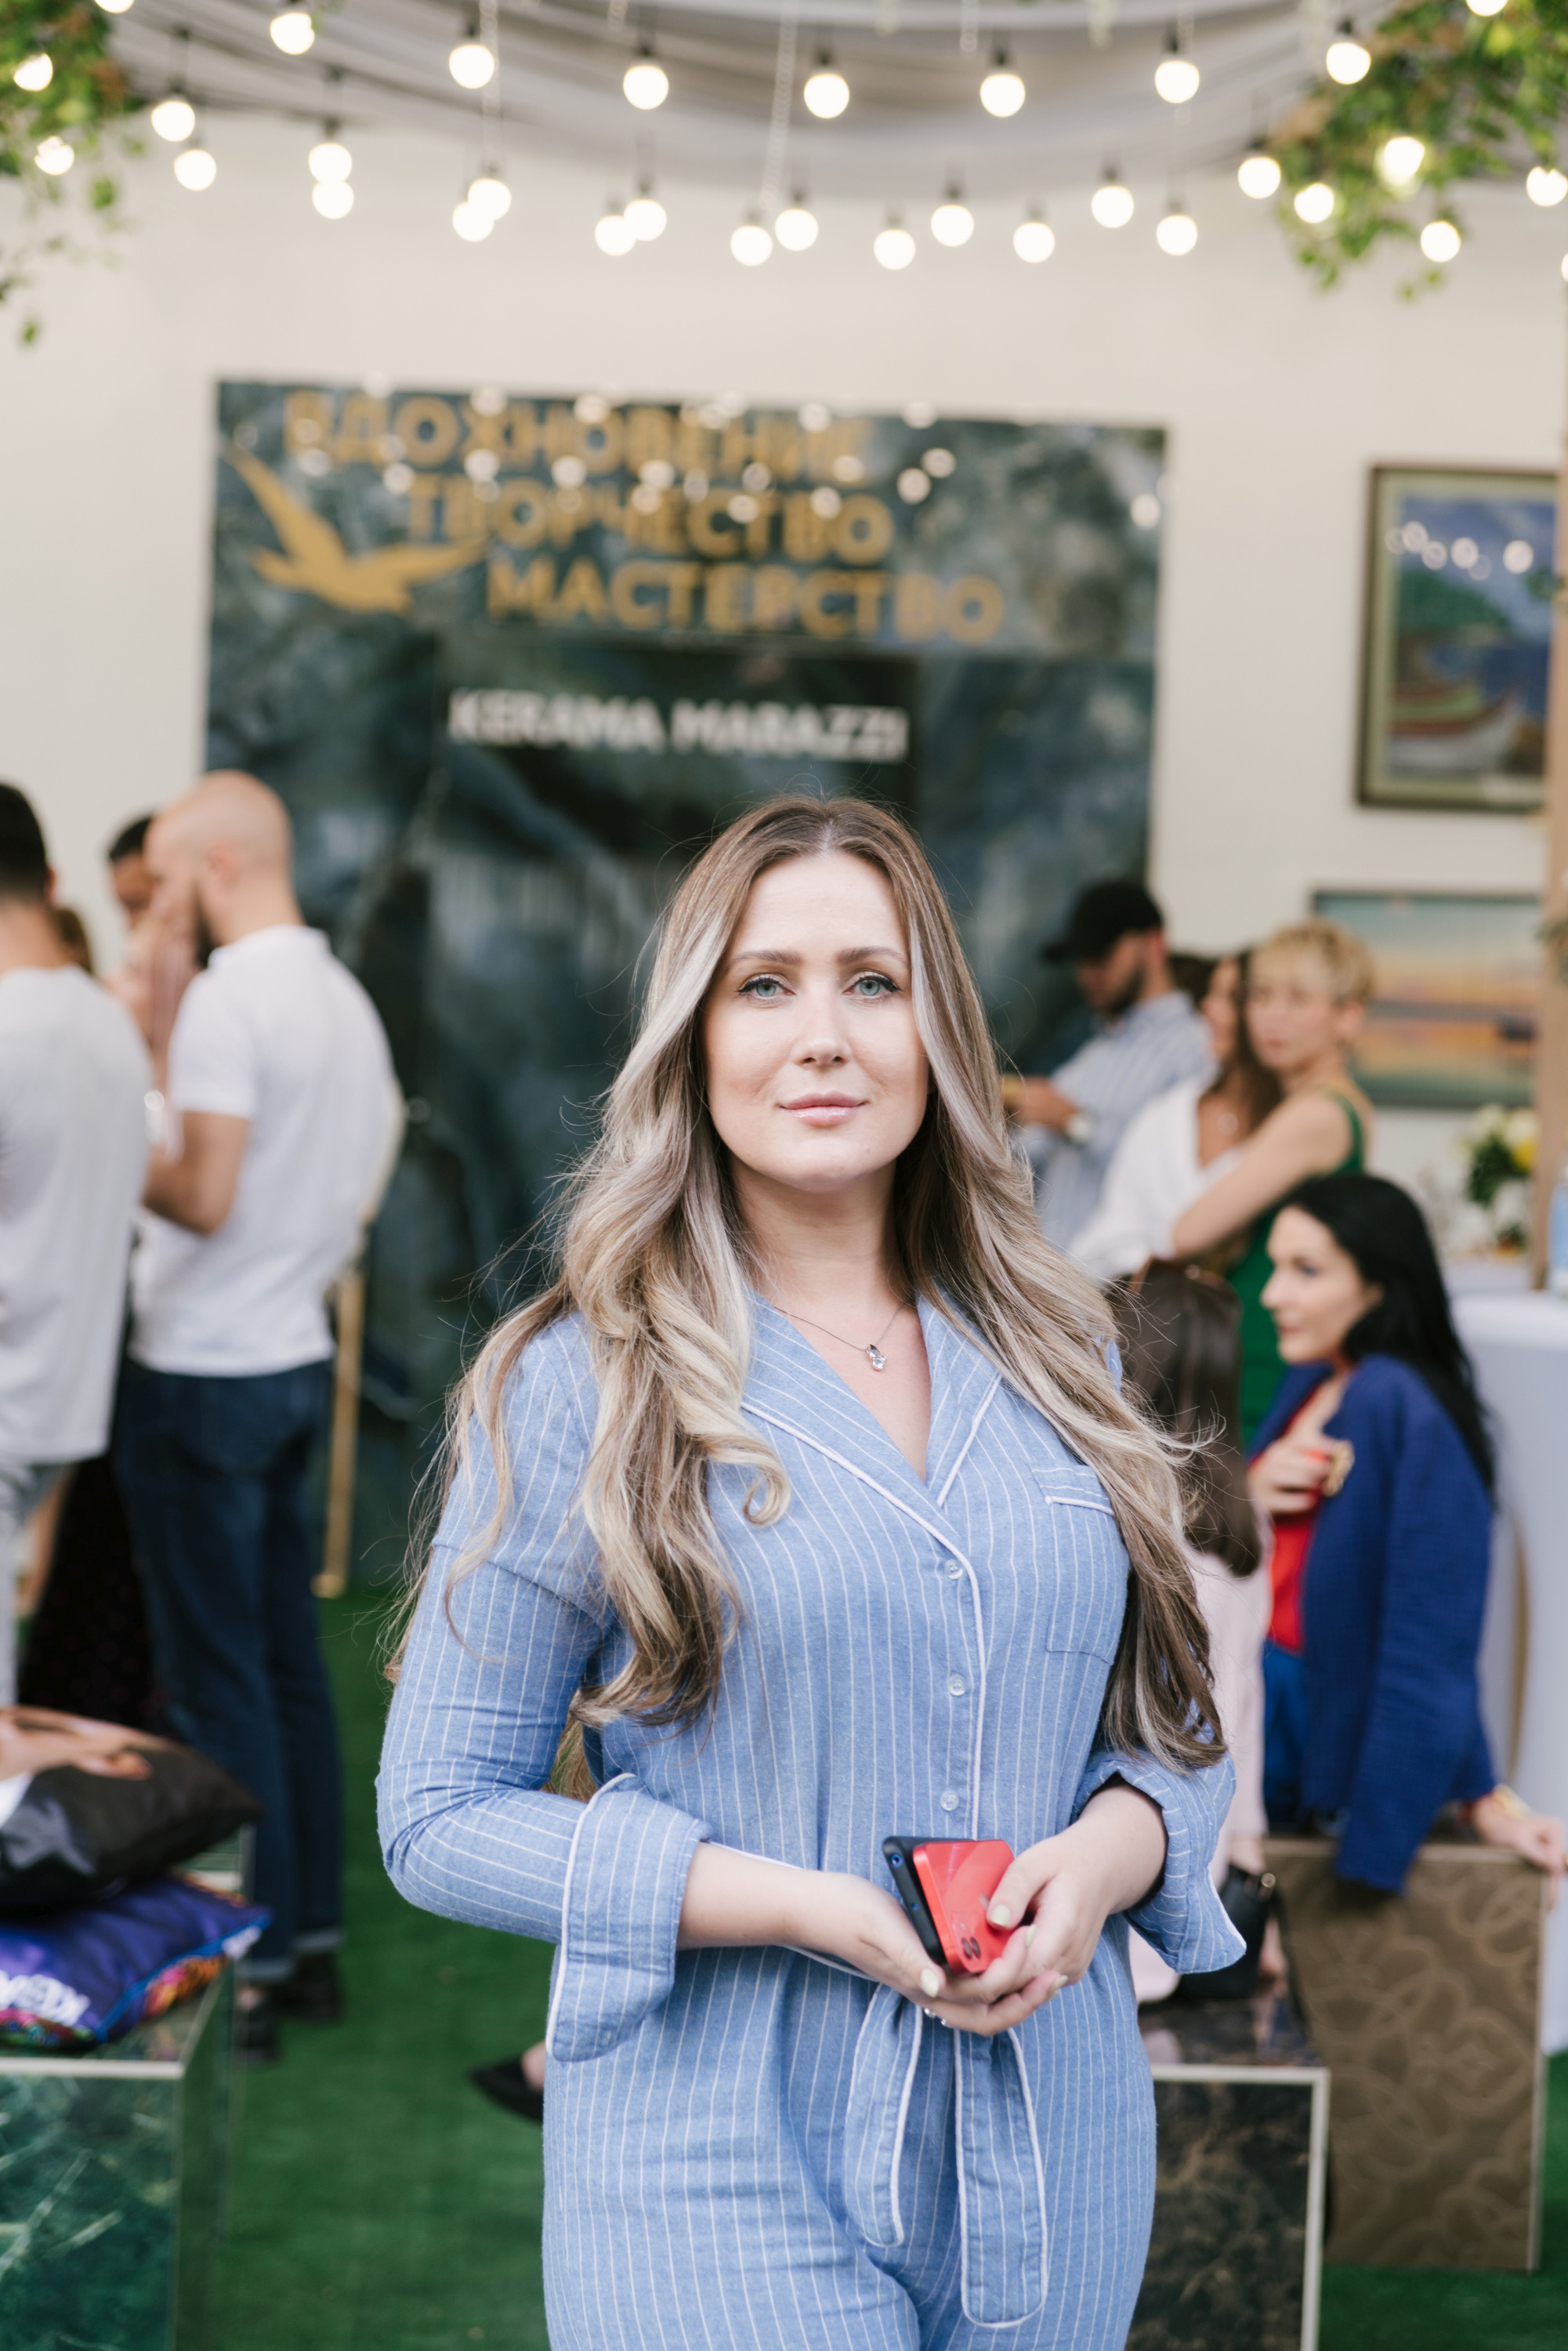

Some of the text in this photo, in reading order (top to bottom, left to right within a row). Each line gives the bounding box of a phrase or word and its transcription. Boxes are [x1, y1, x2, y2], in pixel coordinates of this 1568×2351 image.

[408, 473, 893, 566] ТВОРЧЕСТВО
[487, 554, 1005, 646] МАСТЕРСТВО
[450, 690, 908, 762] KERAMA MARAZZI
